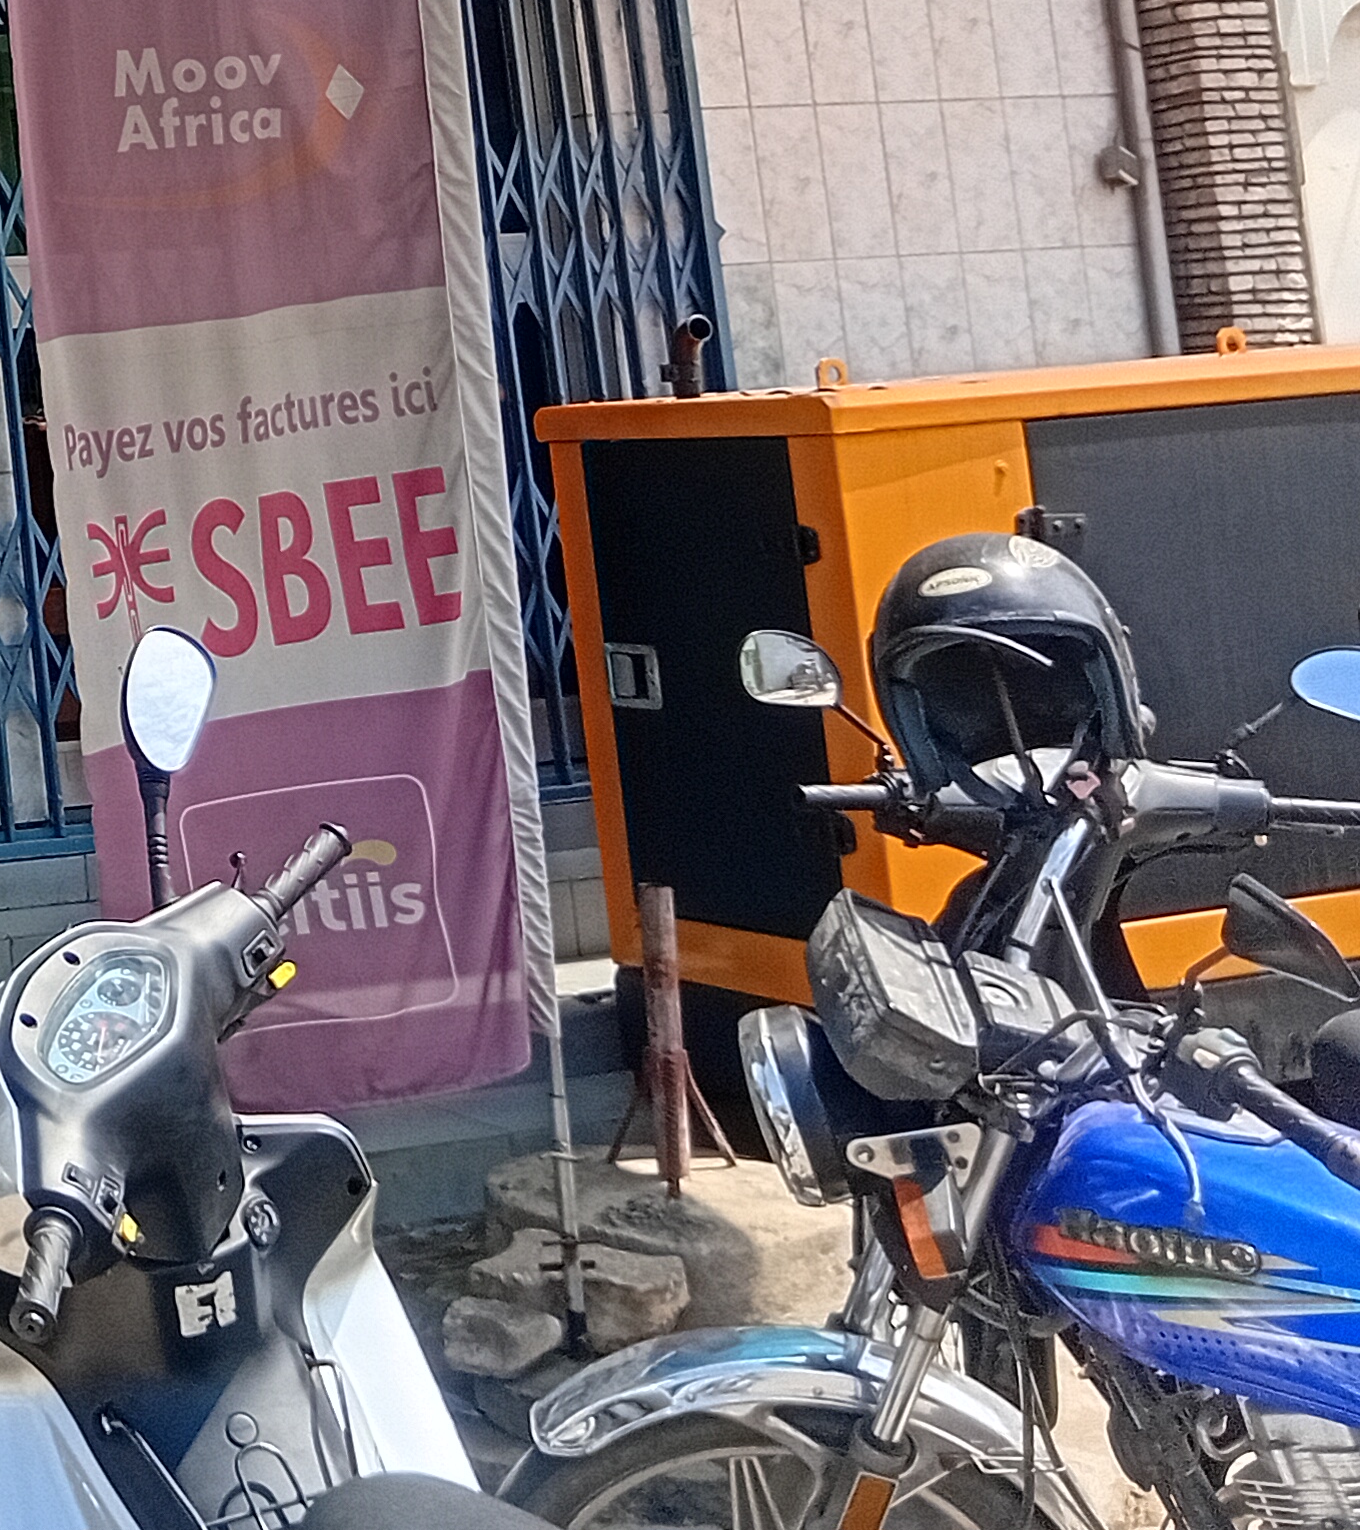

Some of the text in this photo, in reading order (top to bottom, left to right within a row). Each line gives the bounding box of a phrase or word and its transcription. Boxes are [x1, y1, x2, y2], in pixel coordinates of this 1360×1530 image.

[114, 47, 281, 97] Moov
[117, 95, 281, 153] Africa
[63, 365, 439, 479] Payez vos factures ici
[191, 465, 462, 659] SBEE
